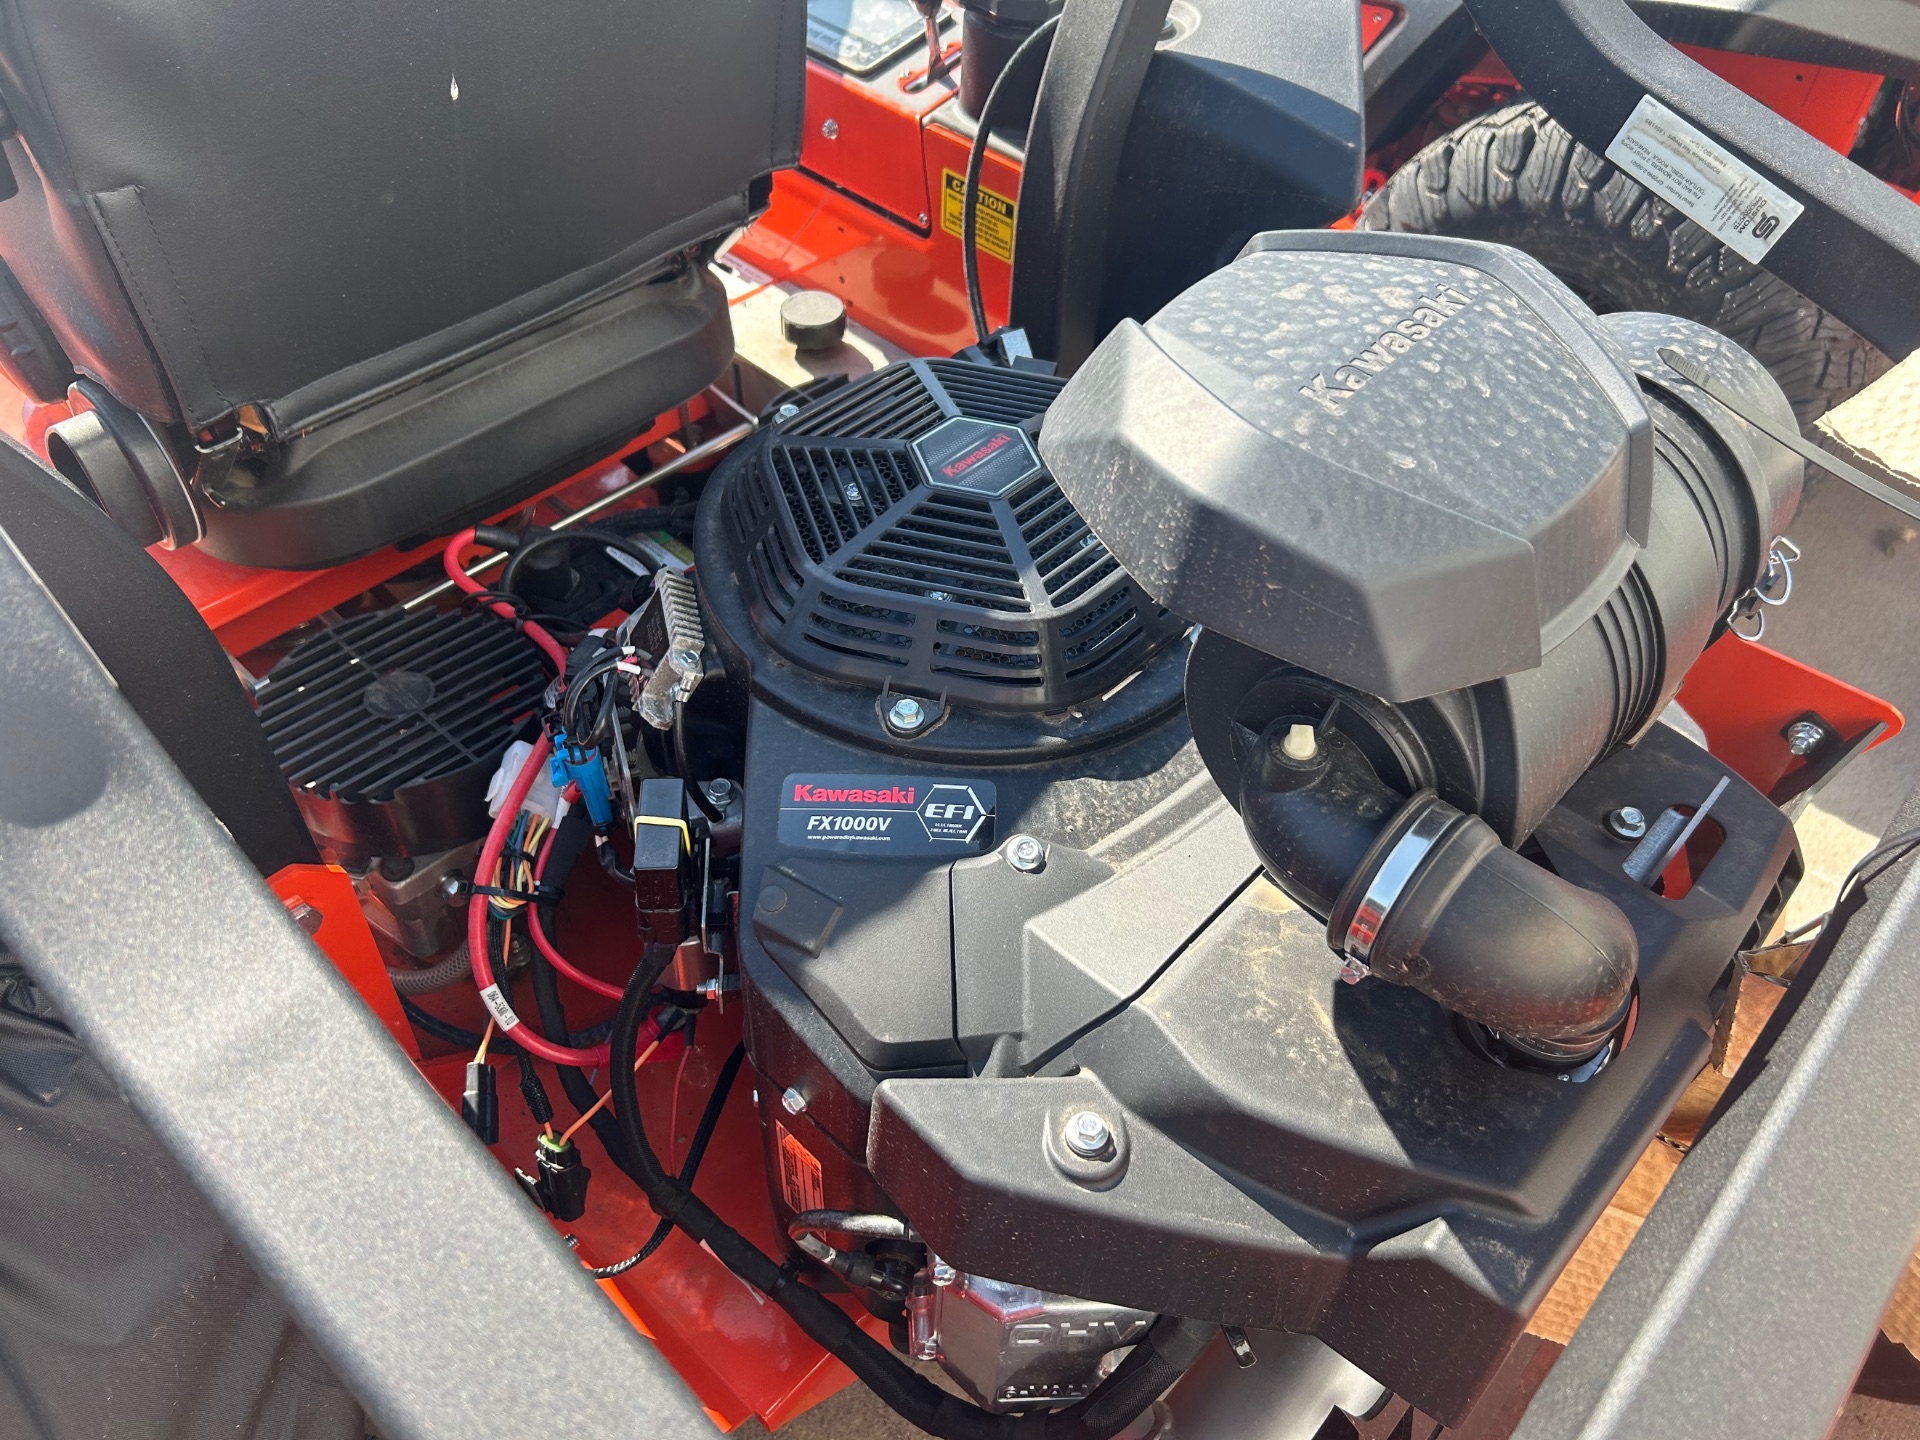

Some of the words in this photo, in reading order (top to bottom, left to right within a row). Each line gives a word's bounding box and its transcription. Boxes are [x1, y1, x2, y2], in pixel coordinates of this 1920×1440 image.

[1633, 148, 1646, 160] POST
[1681, 144, 1691, 153] Test
[1671, 176, 1682, 186] BOY
[1680, 183, 1692, 193] BAD
[952, 179, 1007, 214] CTION
[1732, 195, 1762, 230] PRODUCTS
[1736, 198, 1767, 233] CUSTOM
[1298, 283, 1473, 412] Kawasaki
[942, 433, 1012, 477] Kawasaki
[793, 784, 915, 804] Kawasaki
[924, 803, 975, 820] EFI
[807, 815, 892, 831] FX1000V
[1009, 1320, 1146, 1346] OHV
